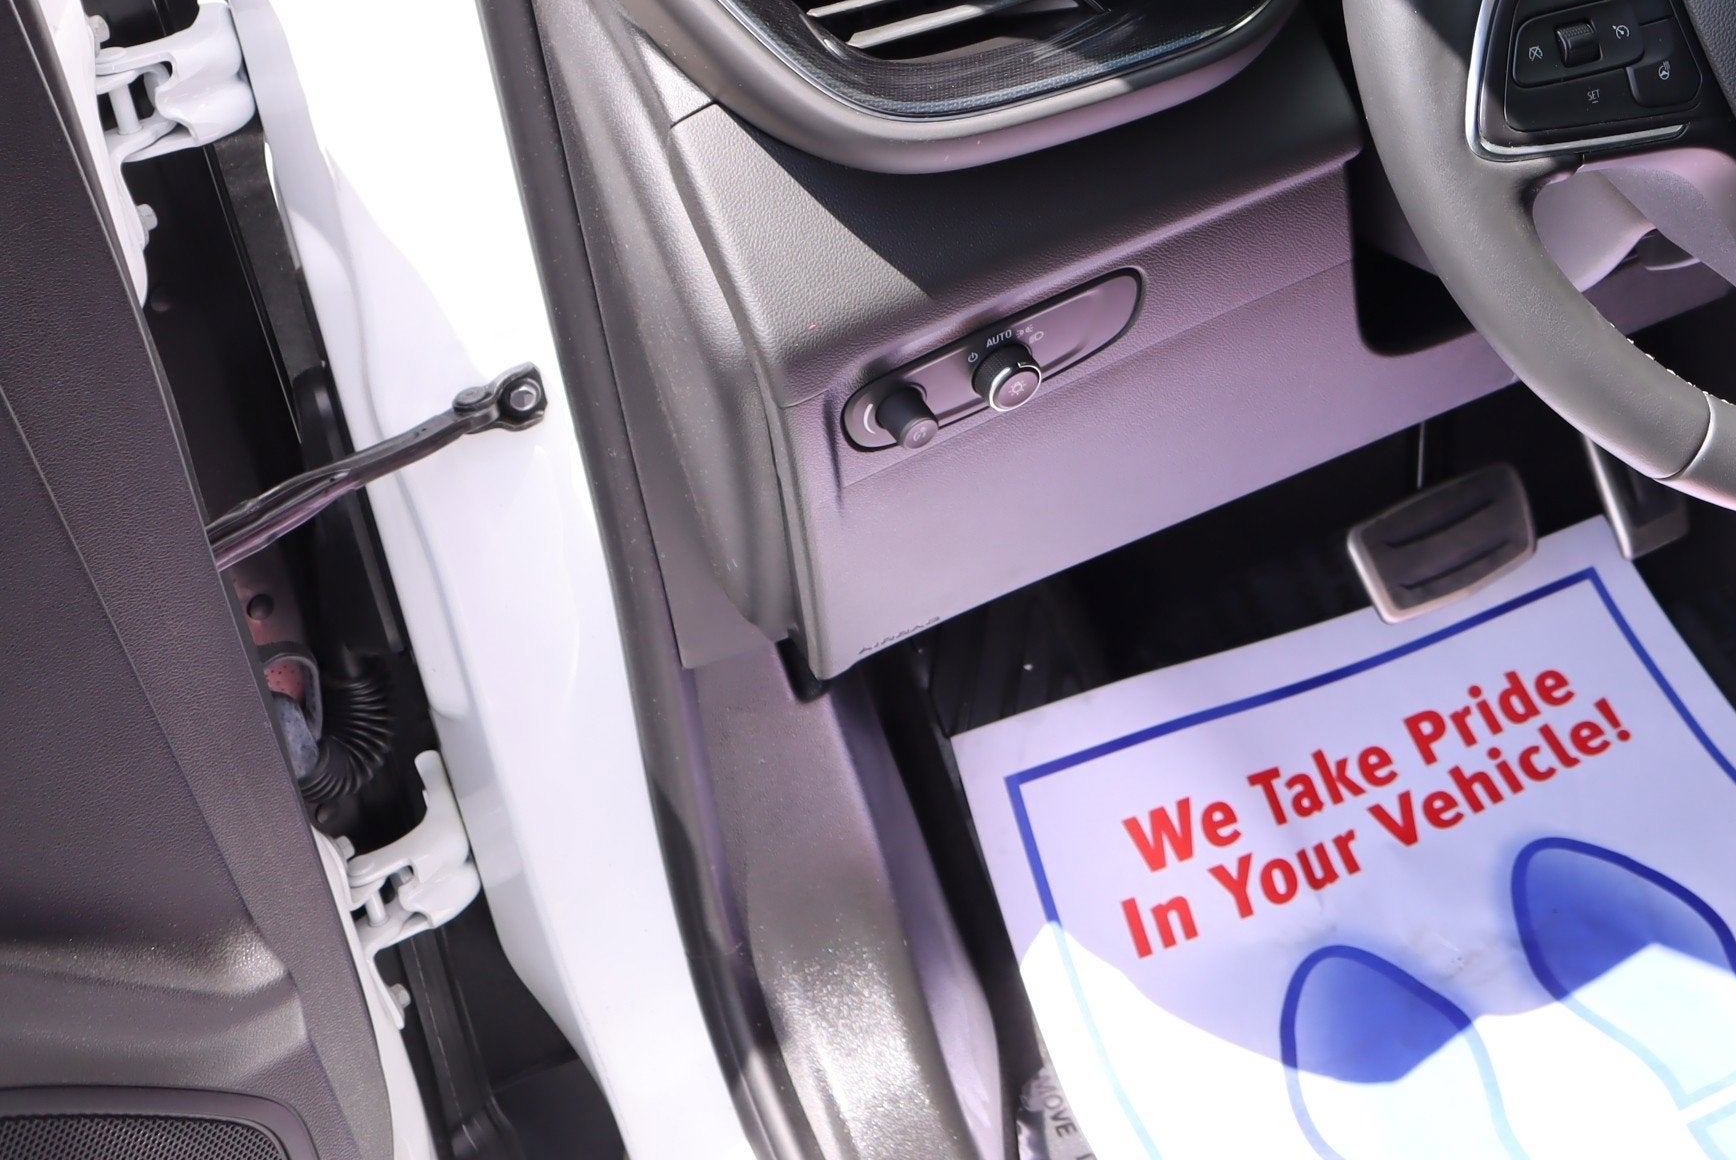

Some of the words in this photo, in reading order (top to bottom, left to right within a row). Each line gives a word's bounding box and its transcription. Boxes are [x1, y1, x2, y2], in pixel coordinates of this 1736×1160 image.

[1586, 88, 1601, 101] SET
[986, 329, 1013, 349] AUTO
[1121, 796, 1242, 873] We
[1246, 744, 1399, 827] Take
[1402, 665, 1576, 767] Pride
[1120, 895, 1200, 960] In
[1207, 828, 1362, 920] Your
[1366, 696, 1633, 848] Vehicle!
